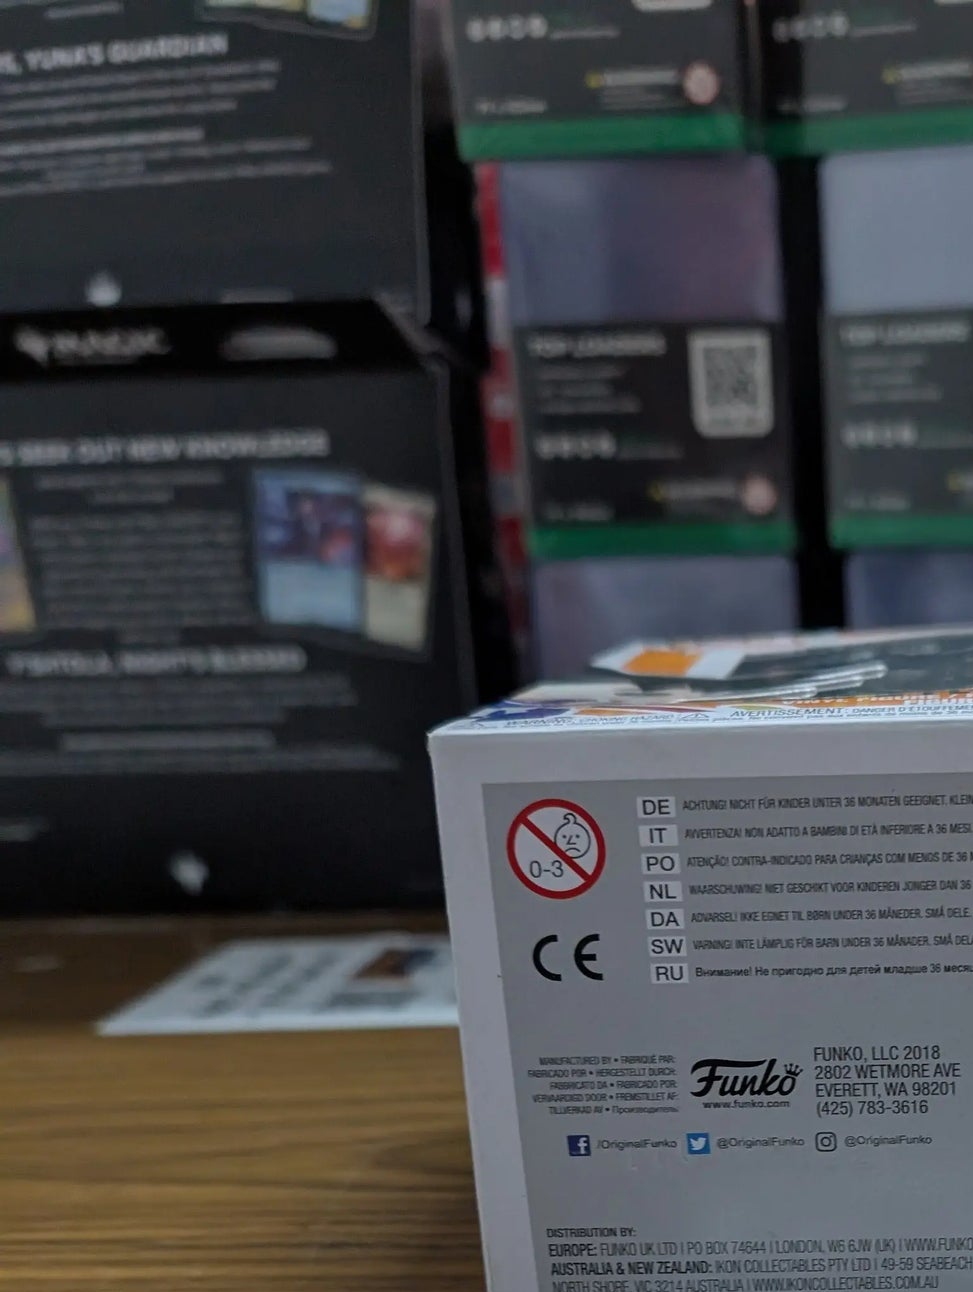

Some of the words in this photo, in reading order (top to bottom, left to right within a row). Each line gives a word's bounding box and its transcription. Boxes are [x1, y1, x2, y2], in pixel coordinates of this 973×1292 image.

[642, 799, 671, 816] DE
[649, 827, 668, 844] IT
[530, 859, 565, 878] 0-3
[646, 855, 676, 872] PO
[649, 883, 677, 900] NL
[650, 911, 680, 927] DA
[651, 938, 684, 954] SW
[532, 933, 604, 982] CE
[655, 965, 684, 982] RU
[813, 1046, 868, 1063] FUNKO,
[872, 1045, 900, 1061] LLC
[903, 1044, 941, 1060] 2018
[690, 1058, 800, 1098] Funko
[814, 1064, 851, 1080] 2802
[855, 1063, 930, 1078] WETMORE
[933, 1062, 961, 1077] AVE
[815, 1082, 882, 1099] EVERETT,
[885, 1082, 908, 1096] WA
[912, 1081, 957, 1096] 98201
[702, 1099, 790, 1109] www.funko.com
[816, 1100, 854, 1117] (425)
[858, 1099, 929, 1114] 783-3616
[717, 1137, 805, 1150] @OriginalFunko
[844, 1135, 932, 1148] @OriginalFunko
[546, 1228, 618, 1238] DISTRIBUTION
[620, 1227, 637, 1237] BY:
[548, 1243, 597, 1257] EUROPE:
[600, 1242, 637, 1256] FUNKO
[640, 1242, 654, 1256] UK
[656, 1241, 678, 1256] LTD
[687, 1240, 702, 1255] PO
[706, 1240, 728, 1255] BOX
[730, 1240, 767, 1254] 74644
[827, 1239, 845, 1252] W6
[848, 1238, 871, 1252] 6JW
[874, 1238, 896, 1254] (UK)
[552, 1262, 614, 1276] AUSTRALIA
[616, 1262, 625, 1275] &
[628, 1261, 654, 1274] NEW
[656, 1260, 713, 1274] ZEALAND:
[716, 1260, 741, 1274] IKON
[744, 1258, 826, 1273] COLLECTABLES
[828, 1258, 848, 1272] PTY
[852, 1258, 871, 1272] LTD
[881, 1257, 914, 1271] 49-59
[916, 1256, 973, 1270] SEABEACH
[654, 1279, 683, 1292] 3214
[686, 1278, 744, 1292] AUSTRALIA
